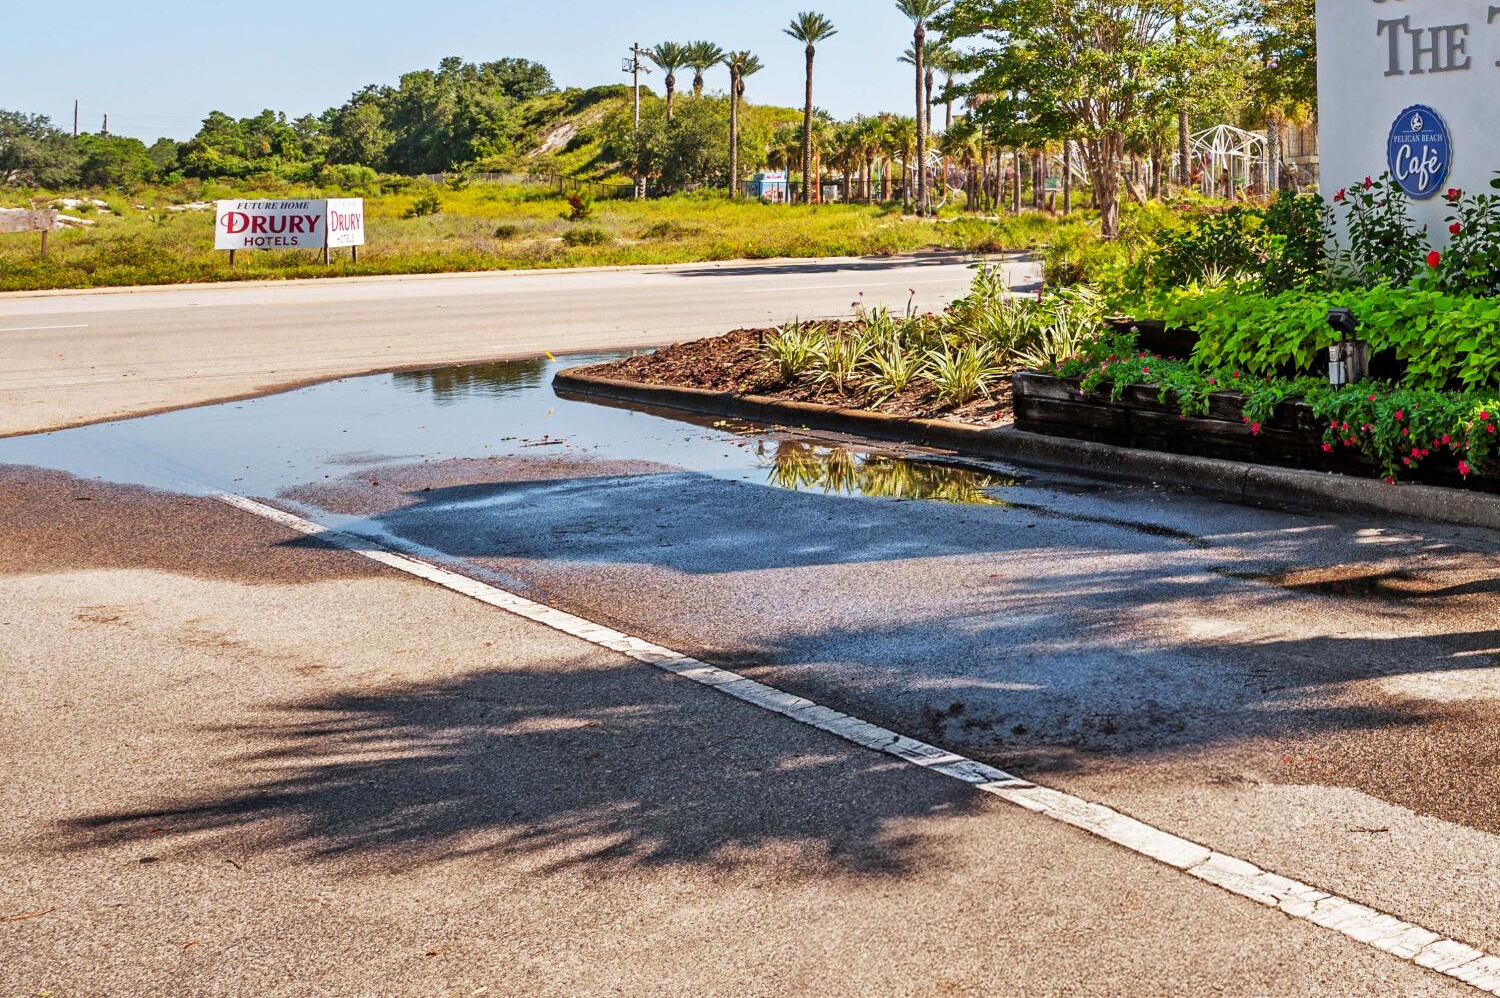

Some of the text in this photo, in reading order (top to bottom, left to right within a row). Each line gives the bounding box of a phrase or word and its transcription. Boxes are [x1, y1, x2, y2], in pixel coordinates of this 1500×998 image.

[1376, 15, 1472, 77] THE
[1393, 133, 1443, 142] PELICAN BEACH
[236, 201, 310, 210] FUTURE HOME
[220, 211, 321, 234] DRURY
[330, 210, 361, 232] DRURY
[244, 236, 299, 247] HOTELS
